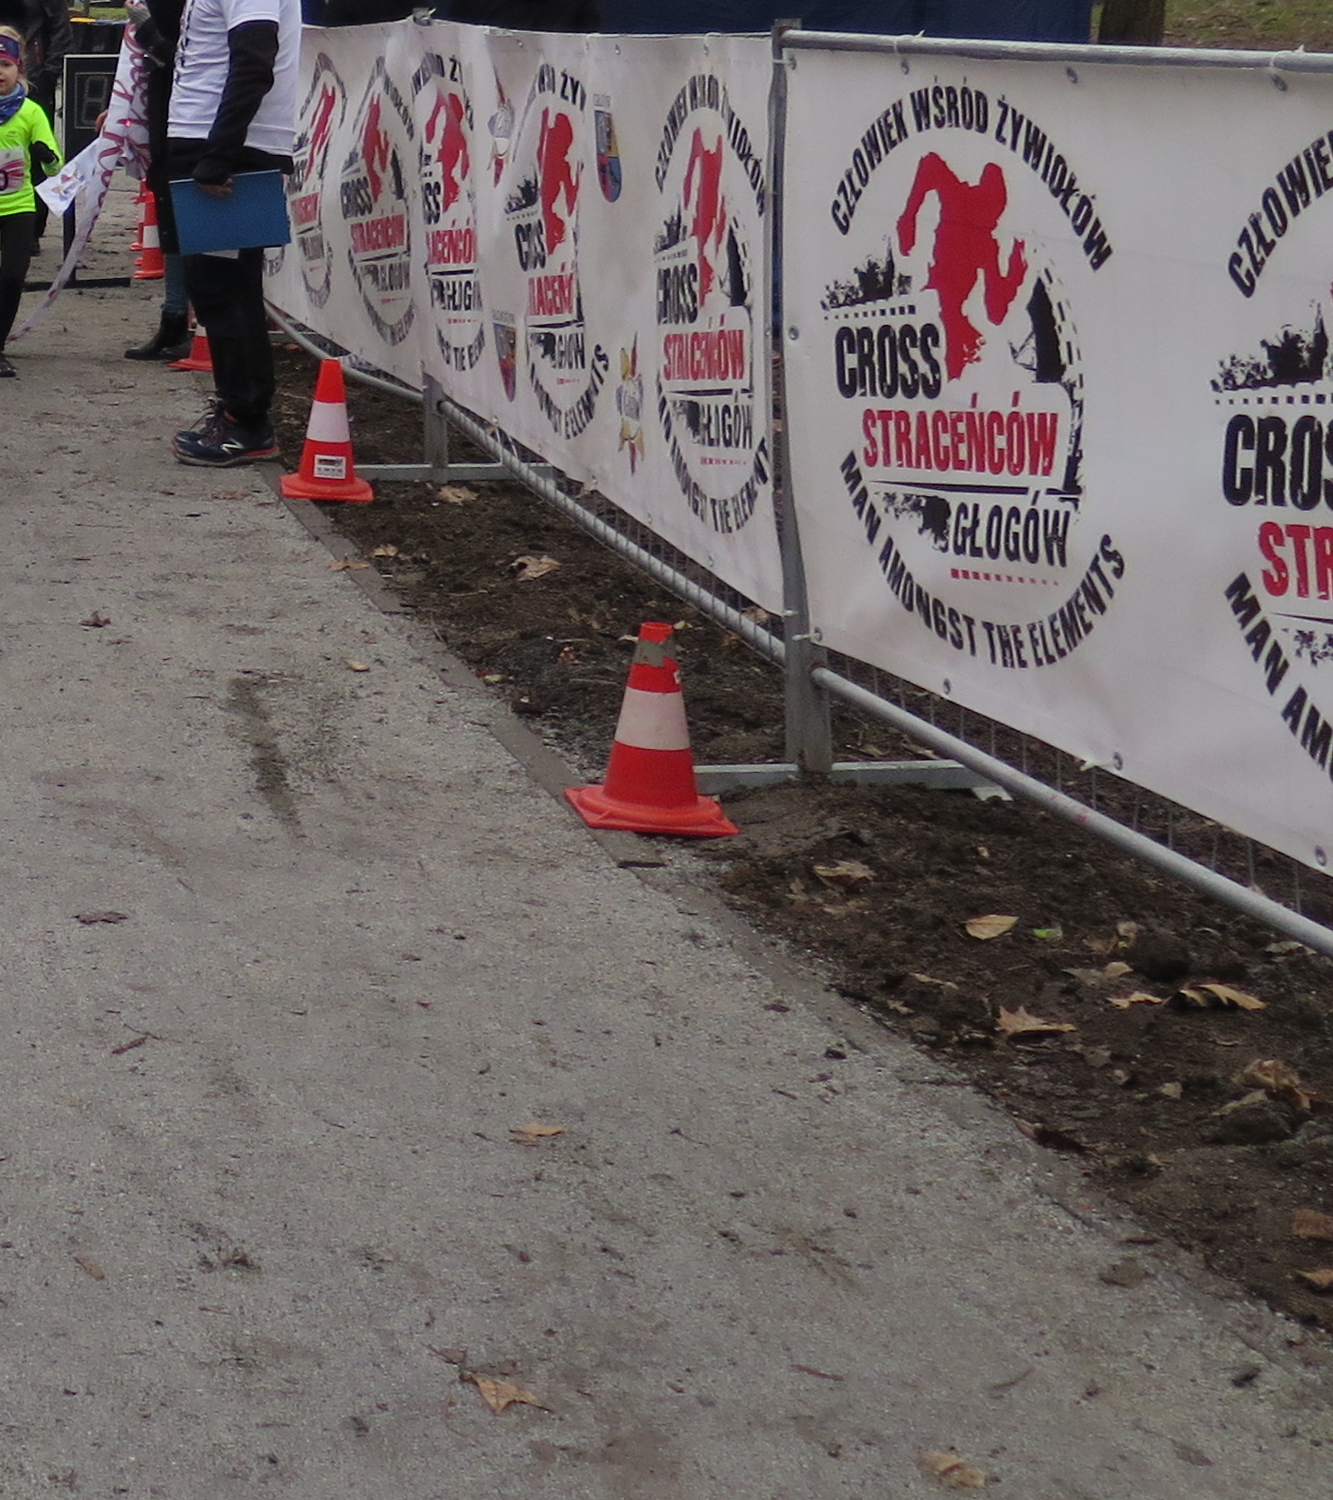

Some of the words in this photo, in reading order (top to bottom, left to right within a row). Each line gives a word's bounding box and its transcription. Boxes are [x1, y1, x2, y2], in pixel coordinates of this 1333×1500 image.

[831, 98, 909, 236] CZŁOWIEK
[909, 76, 989, 134] WŚRÓD
[994, 94, 1114, 272] ŻYWIOŁÓW
[1228, 129, 1333, 299] CZŁOWIE
[834, 323, 942, 399] CROSS
[862, 391, 1058, 477] STRACEŃCÓW
[840, 450, 882, 545] MAN
[878, 535, 977, 656] AMONGST
[981, 620, 1028, 669] THE
[1027, 534, 1125, 668] ELEMENTS
[952, 491, 1071, 568] GŁOGÓW
[1224, 571, 1290, 697] MAN
